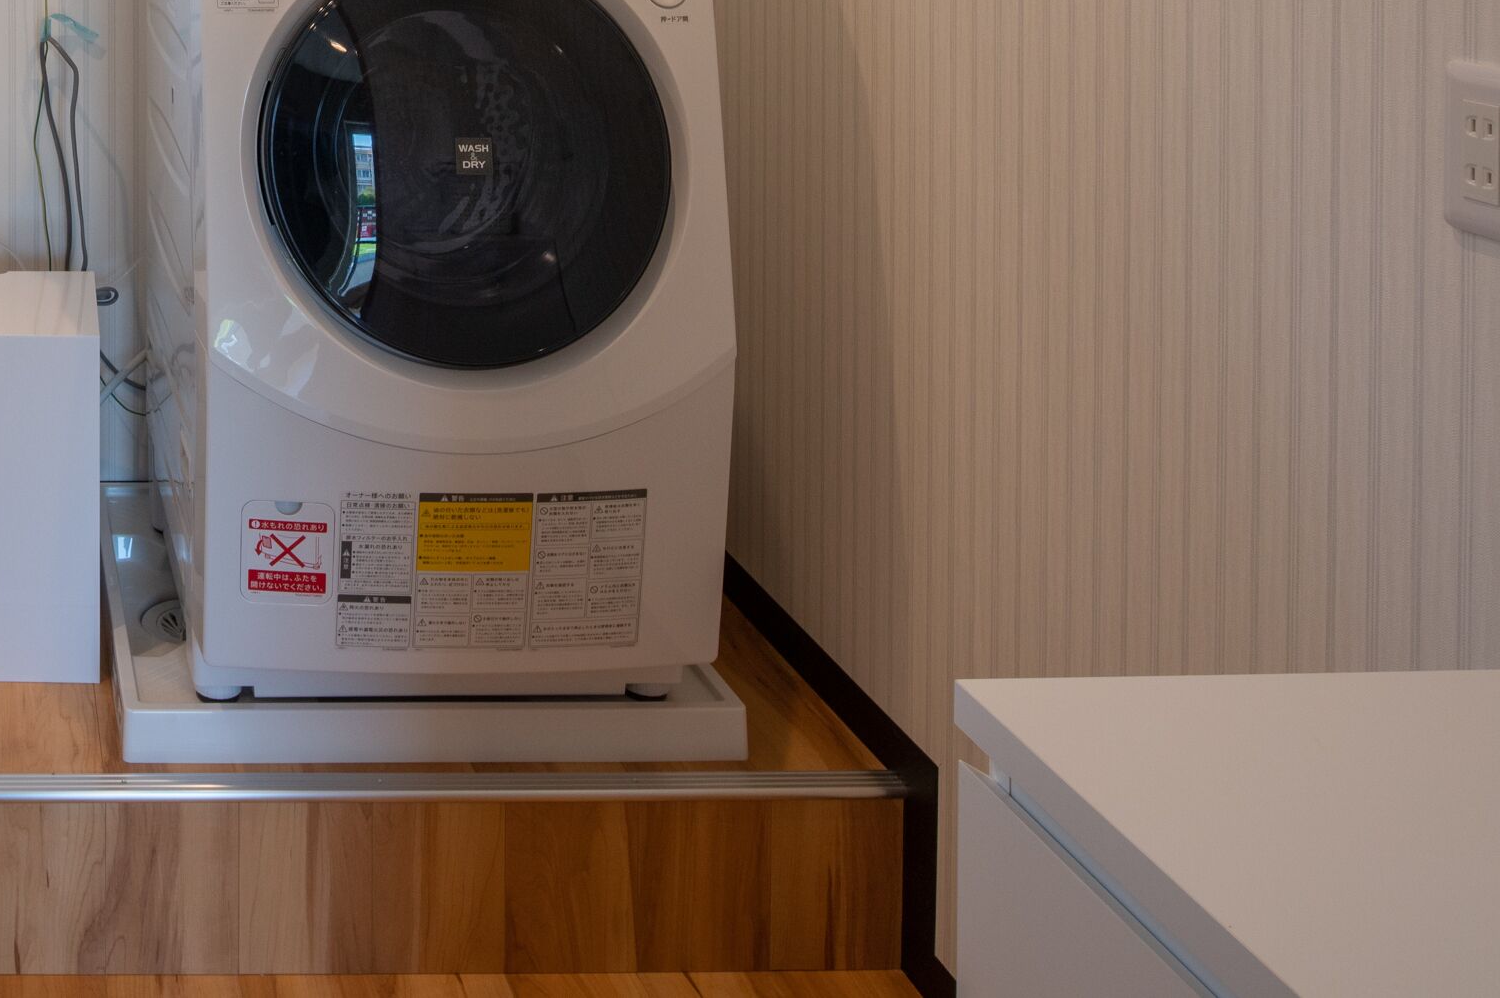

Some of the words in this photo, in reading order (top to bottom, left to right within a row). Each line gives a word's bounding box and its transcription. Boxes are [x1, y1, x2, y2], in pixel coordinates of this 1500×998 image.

[457, 144, 489, 153] WASH
[462, 160, 486, 169] DRY
[346, 492, 412, 500] オーナー様へのお願い
[261, 522, 325, 532] 水もれの恐れあり
[257, 572, 318, 582] 運転中は、ふたを
[250, 581, 323, 592] 開けないでください。
